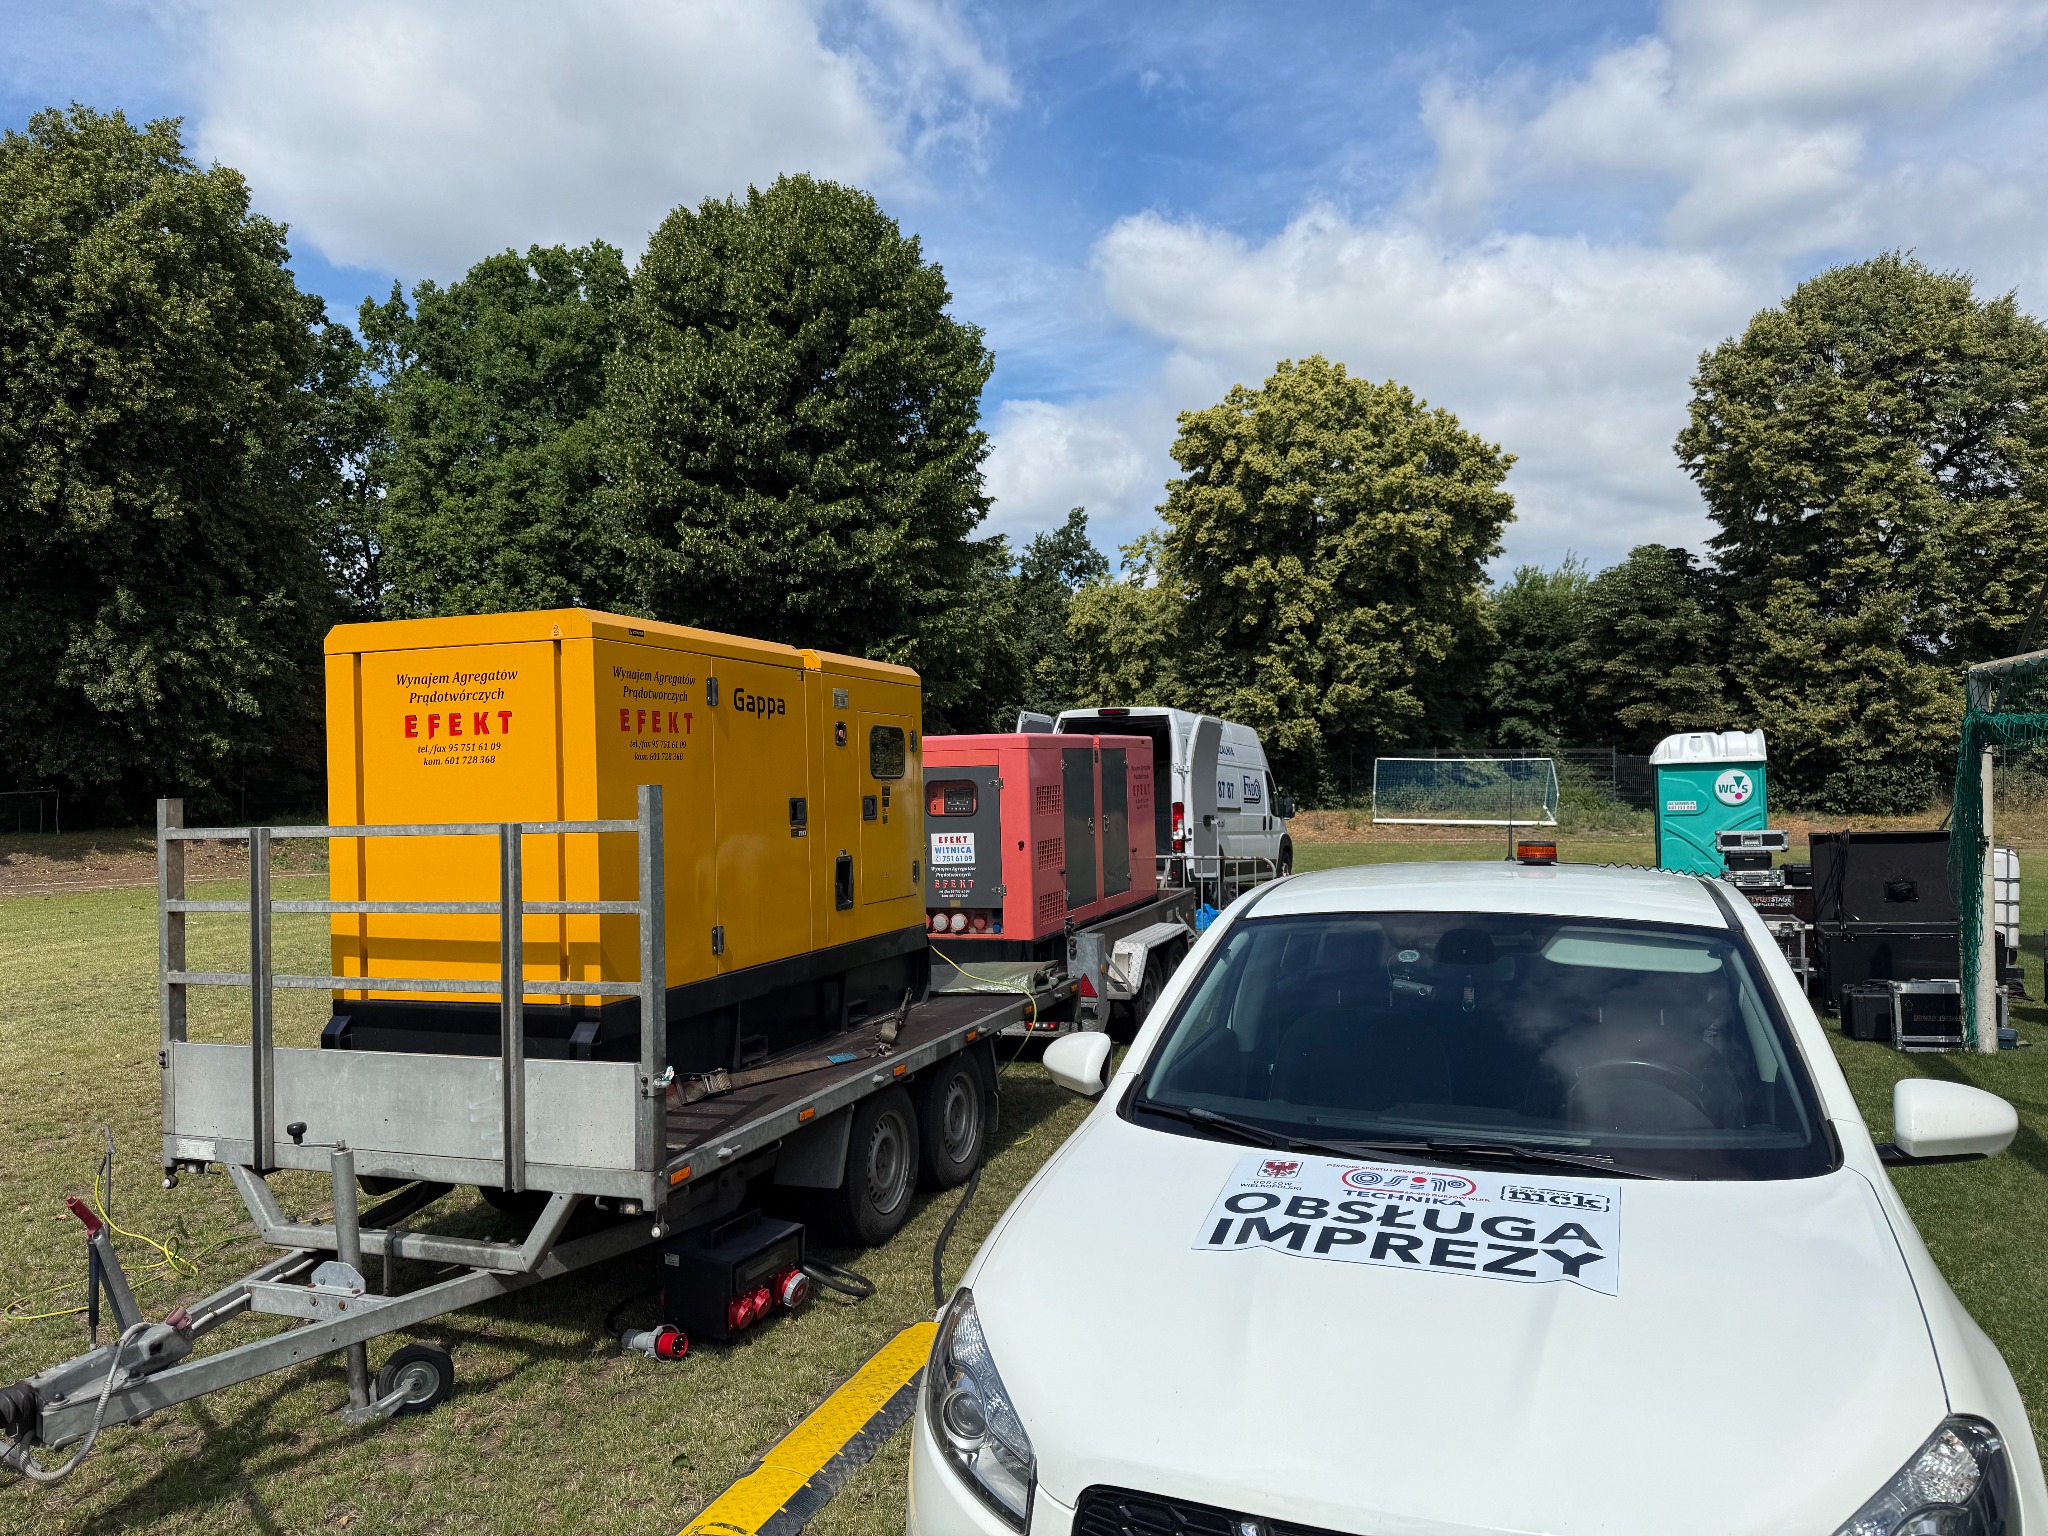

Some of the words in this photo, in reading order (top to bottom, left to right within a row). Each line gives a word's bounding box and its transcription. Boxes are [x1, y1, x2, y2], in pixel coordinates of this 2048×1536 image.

[396, 673, 449, 688] Wynajem
[452, 669, 518, 686] Agregatów
[613, 666, 652, 683] Wynajem
[653, 671, 696, 686] Agregatów
[409, 688, 505, 706] Prądotwórczych
[733, 687, 786, 720] Gappa
[404, 710, 513, 740] EFEKT
[620, 708, 693, 735] EFEKT
[417, 744, 447, 755] tel./fax
[448, 744, 459, 752] 95
[461, 743, 476, 752] 751
[478, 742, 488, 751] 61
[490, 742, 501, 751] 09
[423, 757, 443, 766] kom.
[444, 757, 460, 765] 601
[462, 756, 478, 764] 728
[480, 755, 496, 764] 368
[1226, 782, 1234, 799] 87
[938, 836, 968, 844] EFEKT
[934, 846, 972, 854] WITNICA
[934, 879, 974, 889] EFEKT
[1343, 1189, 1467, 1208] TECHNIKA
[1508, 1191, 1602, 1209] mck
[1224, 1192, 1604, 1250] OBSŁUGA
[1208, 1217, 1607, 1279] IMPREZY
